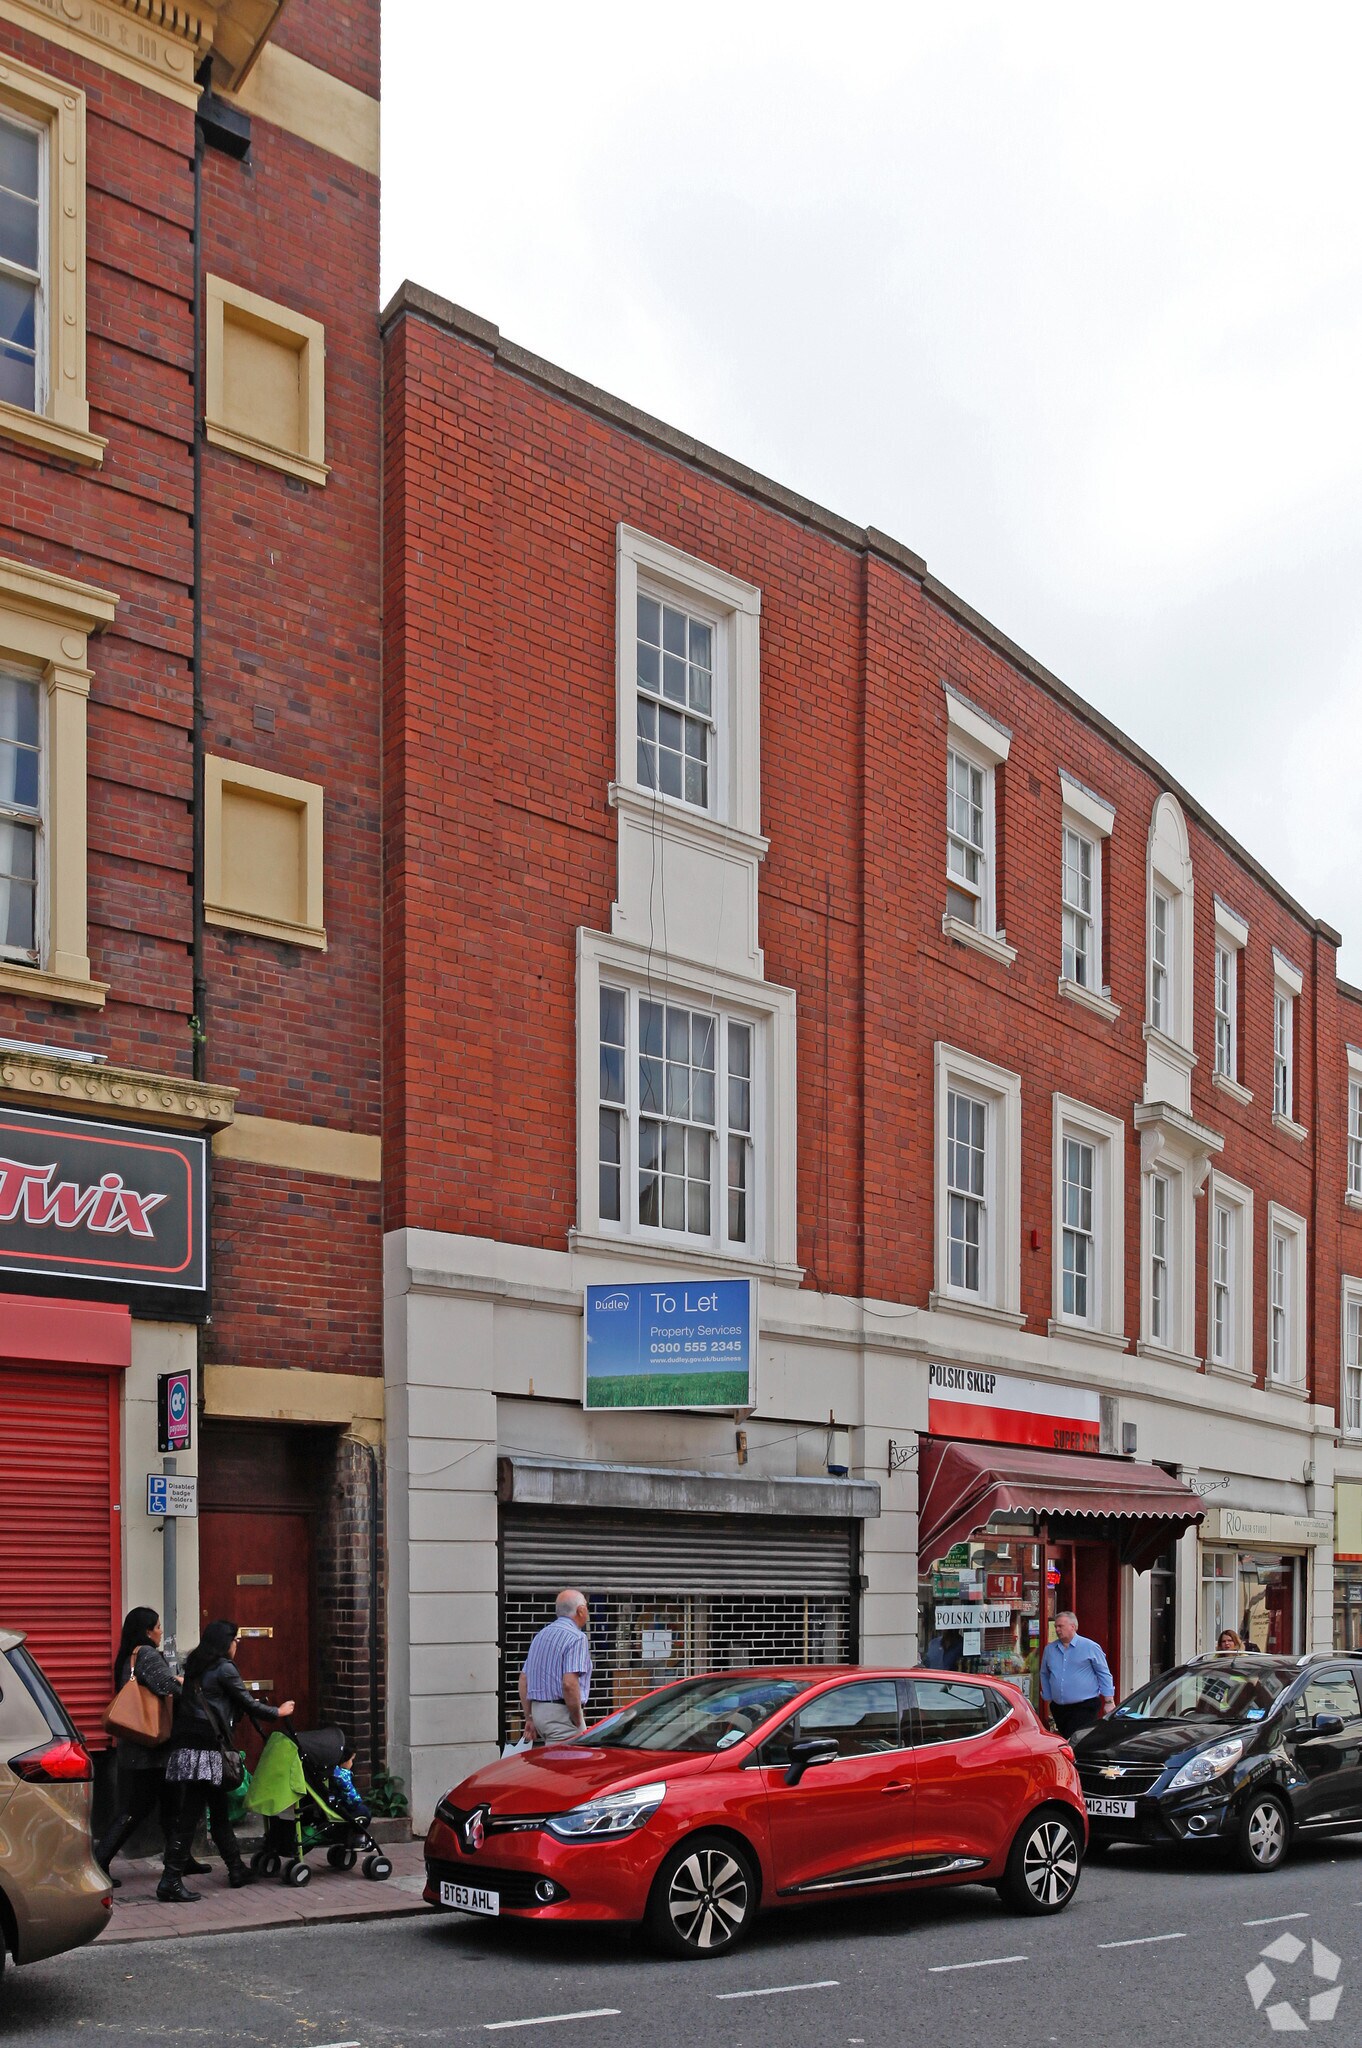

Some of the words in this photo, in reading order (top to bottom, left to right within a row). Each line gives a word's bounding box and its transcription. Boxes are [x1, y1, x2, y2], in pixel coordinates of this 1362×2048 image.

[0, 1157, 168, 1238] Twix
[595, 1300, 629, 1310] Dudley
[650, 1293, 676, 1313] To
[684, 1292, 718, 1312] Let
[650, 1326, 695, 1339] Property
[697, 1325, 742, 1336] Services
[650, 1343, 680, 1353] 0300
[684, 1342, 707, 1352] 555
[711, 1341, 742, 1352] 2345
[929, 1364, 965, 1390] POLSKI
[967, 1371, 996, 1394] SKLEP
[1053, 1429, 1080, 1450] SUPER
[154, 1479, 165, 1493] P
[168, 1482, 195, 1490] Disabled
[937, 1611, 973, 1625] POLSKI
[979, 1610, 1011, 1624] SKLEP
[1105, 1801, 1127, 1814] HSV
[444, 1884, 468, 1905] BT63
[472, 1891, 493, 1910] AHL
